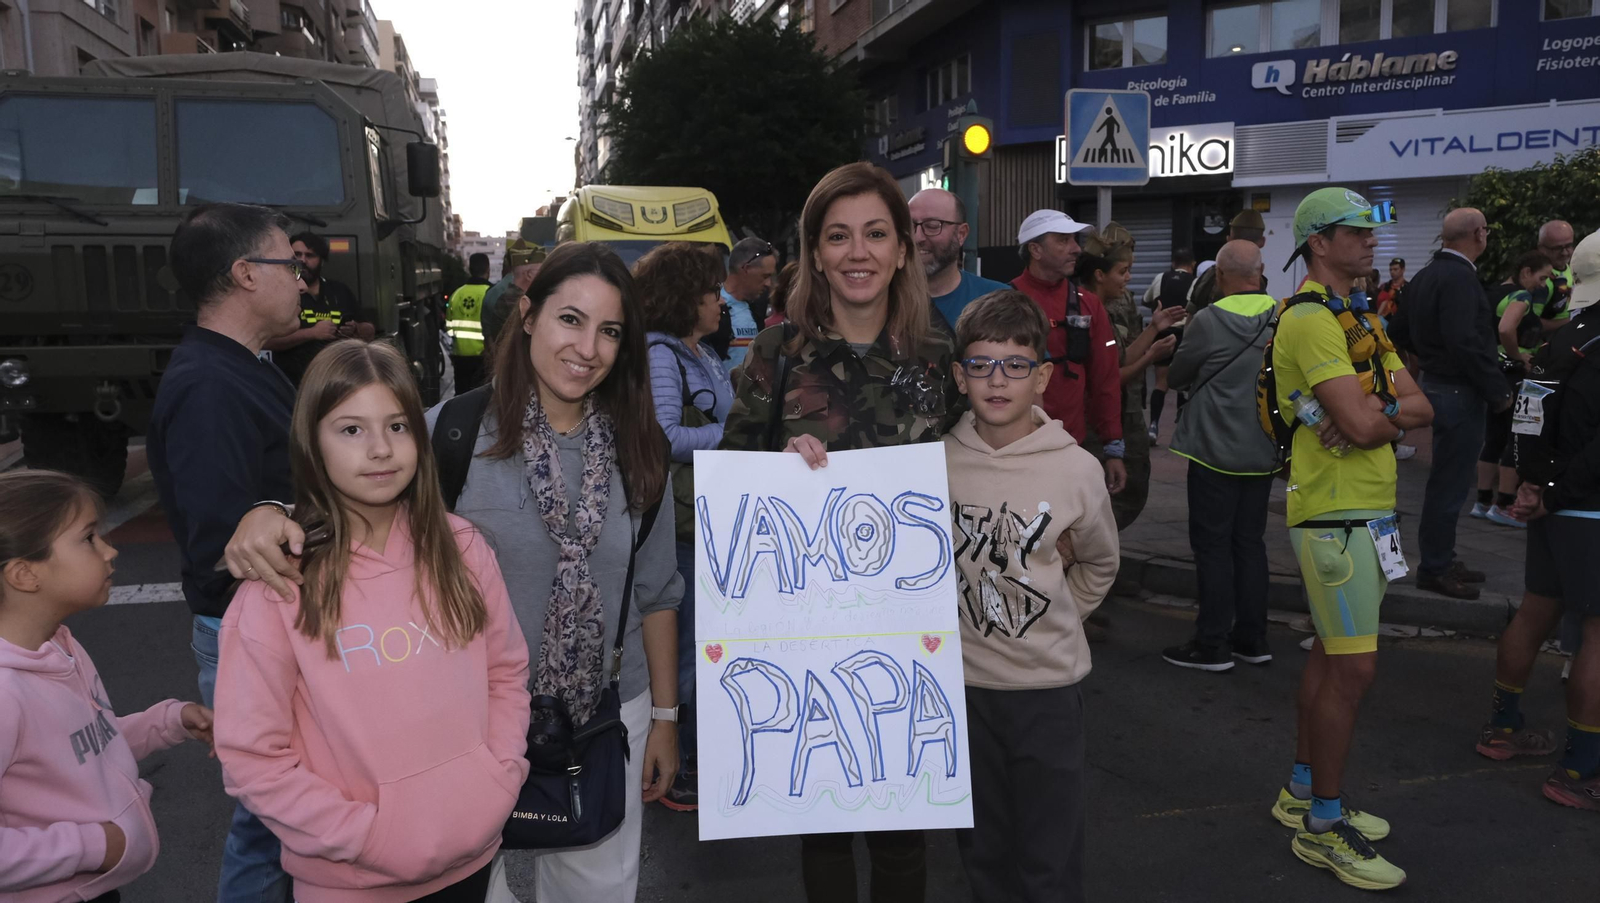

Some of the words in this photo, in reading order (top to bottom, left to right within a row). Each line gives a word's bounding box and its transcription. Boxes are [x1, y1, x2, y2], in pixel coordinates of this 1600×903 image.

[1302, 50, 1459, 84] Háblame
[1127, 75, 1187, 91] Psicología
[1302, 85, 1345, 98] Centro
[1350, 74, 1456, 94] Interdisciplinar
[1154, 95, 1170, 107] de
[1172, 90, 1216, 105] Familia
[1389, 126, 1600, 157] VITALDENT
[696, 487, 952, 598] VAMOS
[335, 622, 460, 673] ROX
[753, 641, 772, 654] LA
[720, 650, 957, 806] PAPA
[512, 810, 539, 820] BIMBA
[547, 814, 568, 822] LOLA
